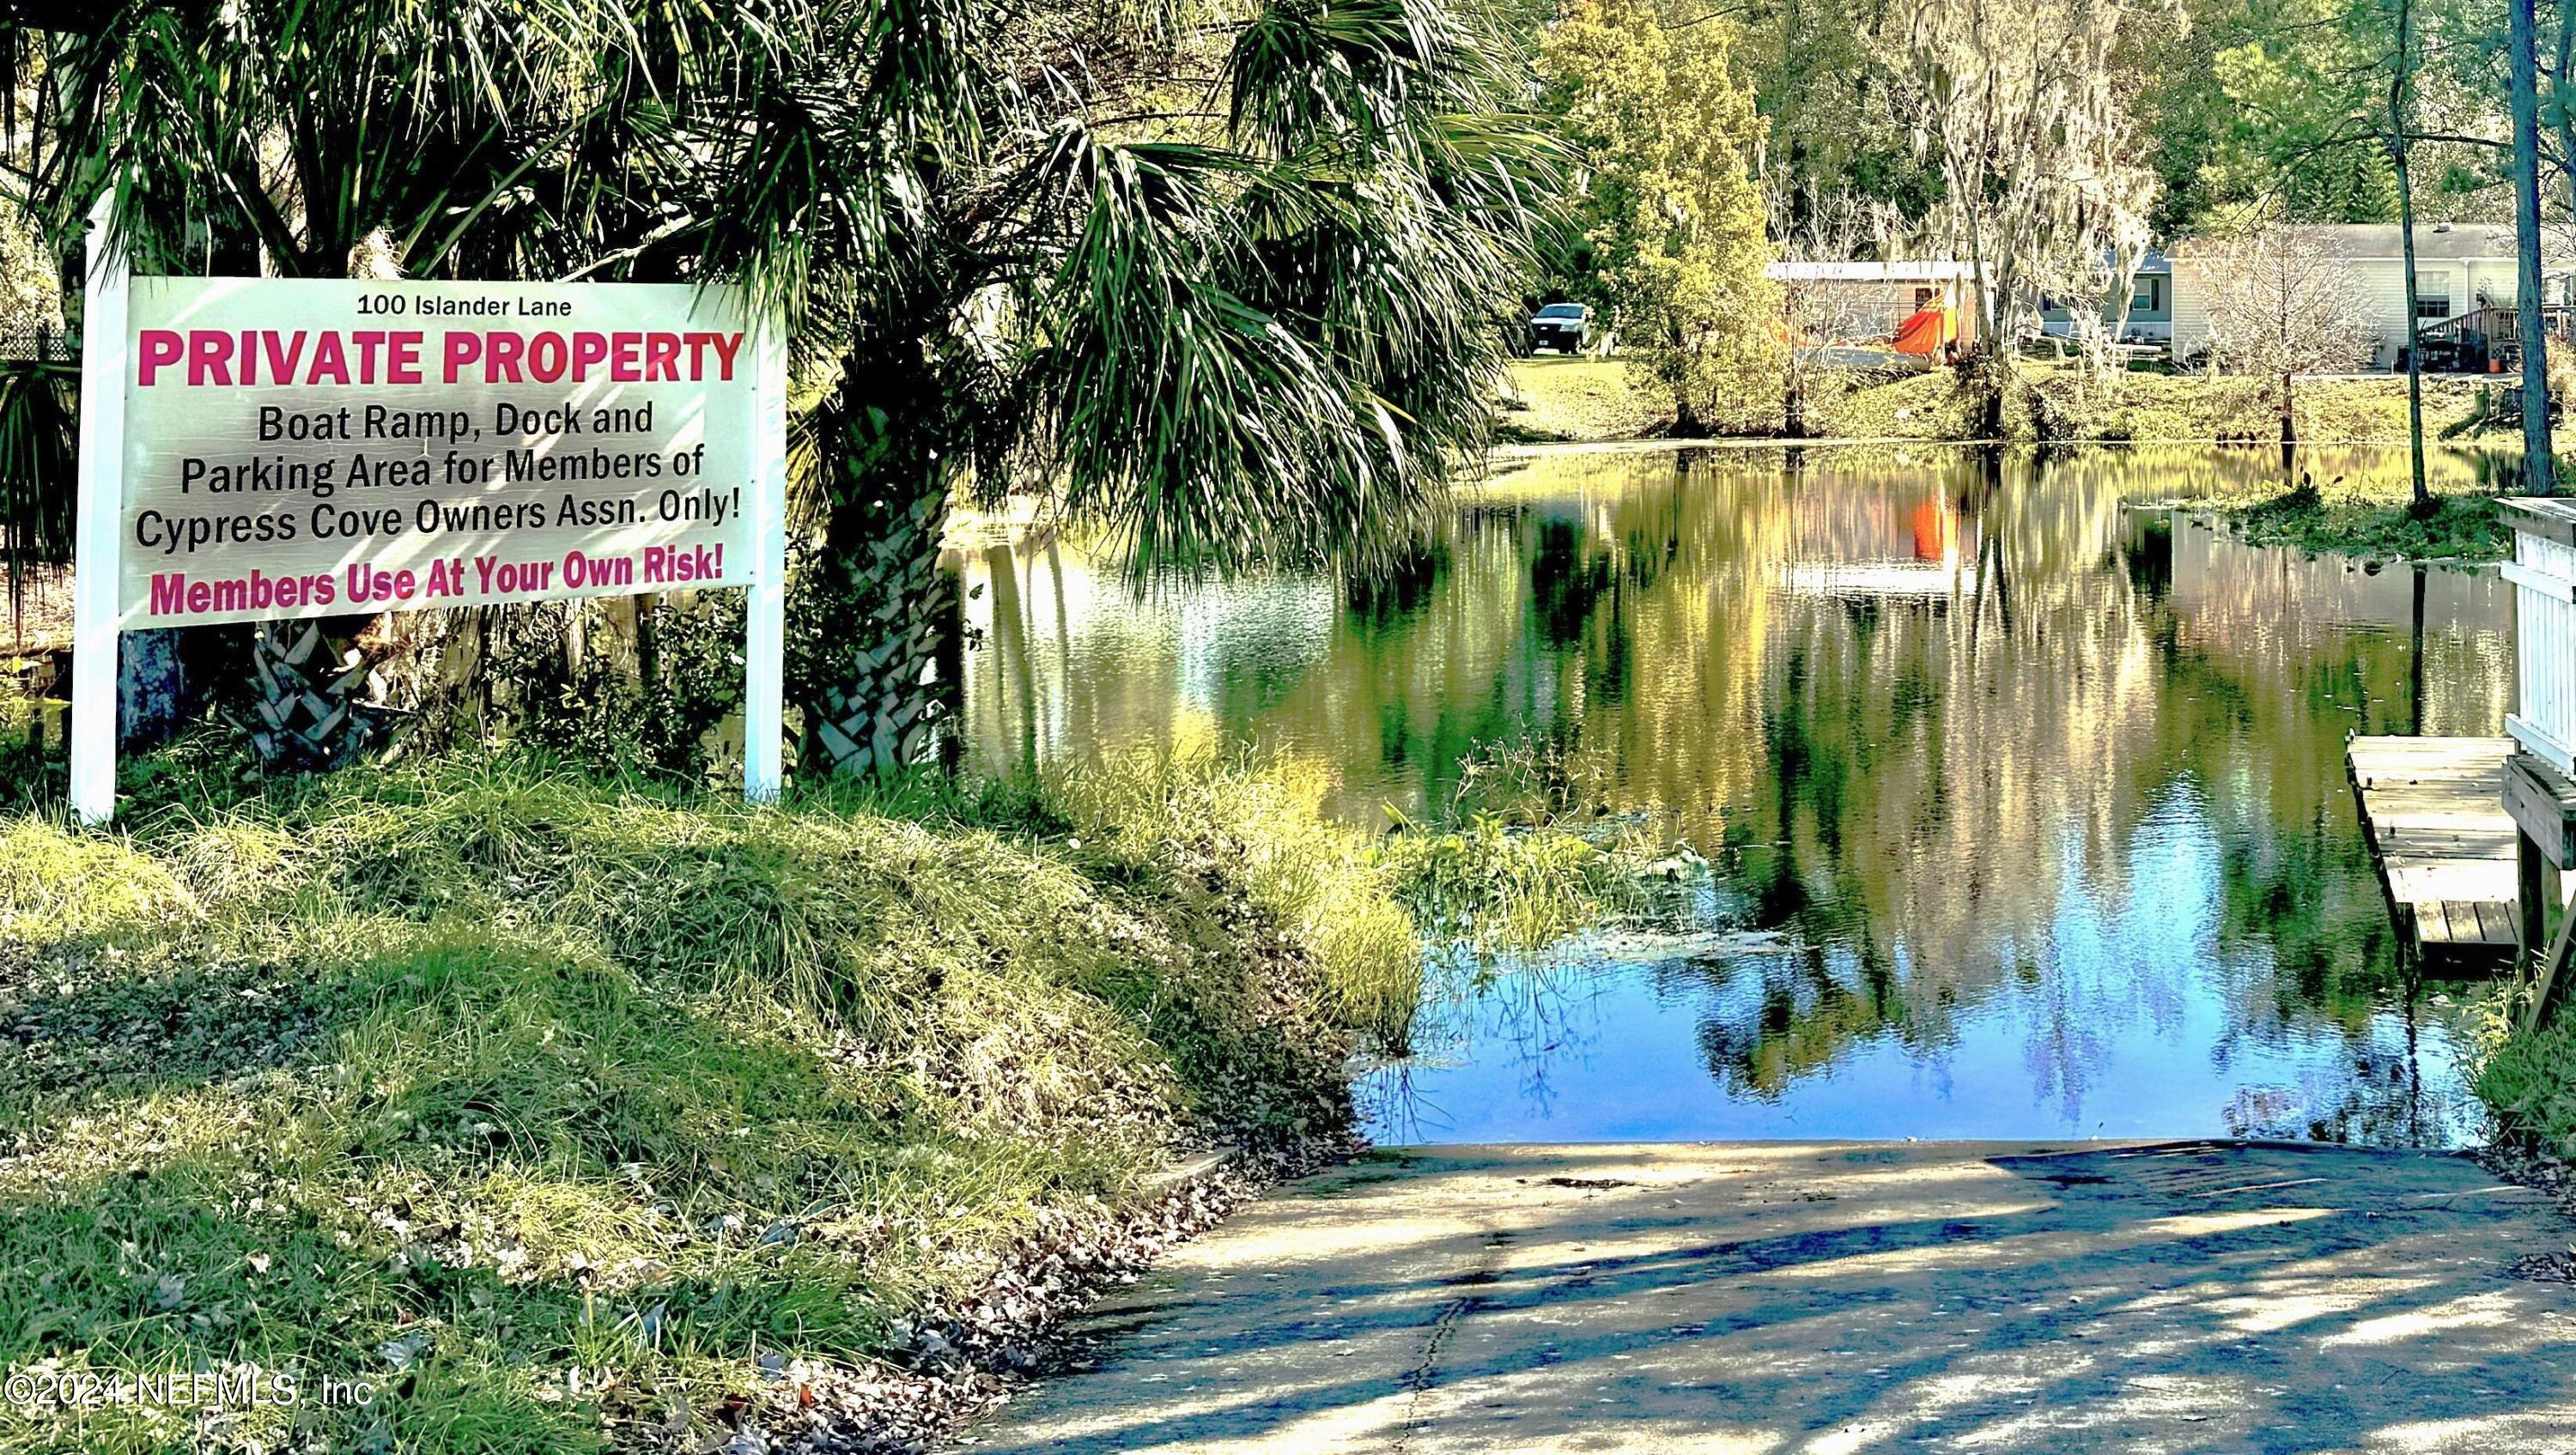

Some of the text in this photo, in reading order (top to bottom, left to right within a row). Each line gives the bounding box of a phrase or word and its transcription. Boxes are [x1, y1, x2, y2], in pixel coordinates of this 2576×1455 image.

[357, 294, 573, 318] 100 Islander Lane
[138, 330, 744, 386] PRIVATE PROPERTY
[258, 401, 653, 444] Boat Ramp, Dock and
[180, 443, 705, 497] Parking Area for Members of
[136, 488, 741, 555] Cypress Cove Owners Assn. Only!
[149, 543, 724, 616] Members Use At Your Own Risk!
